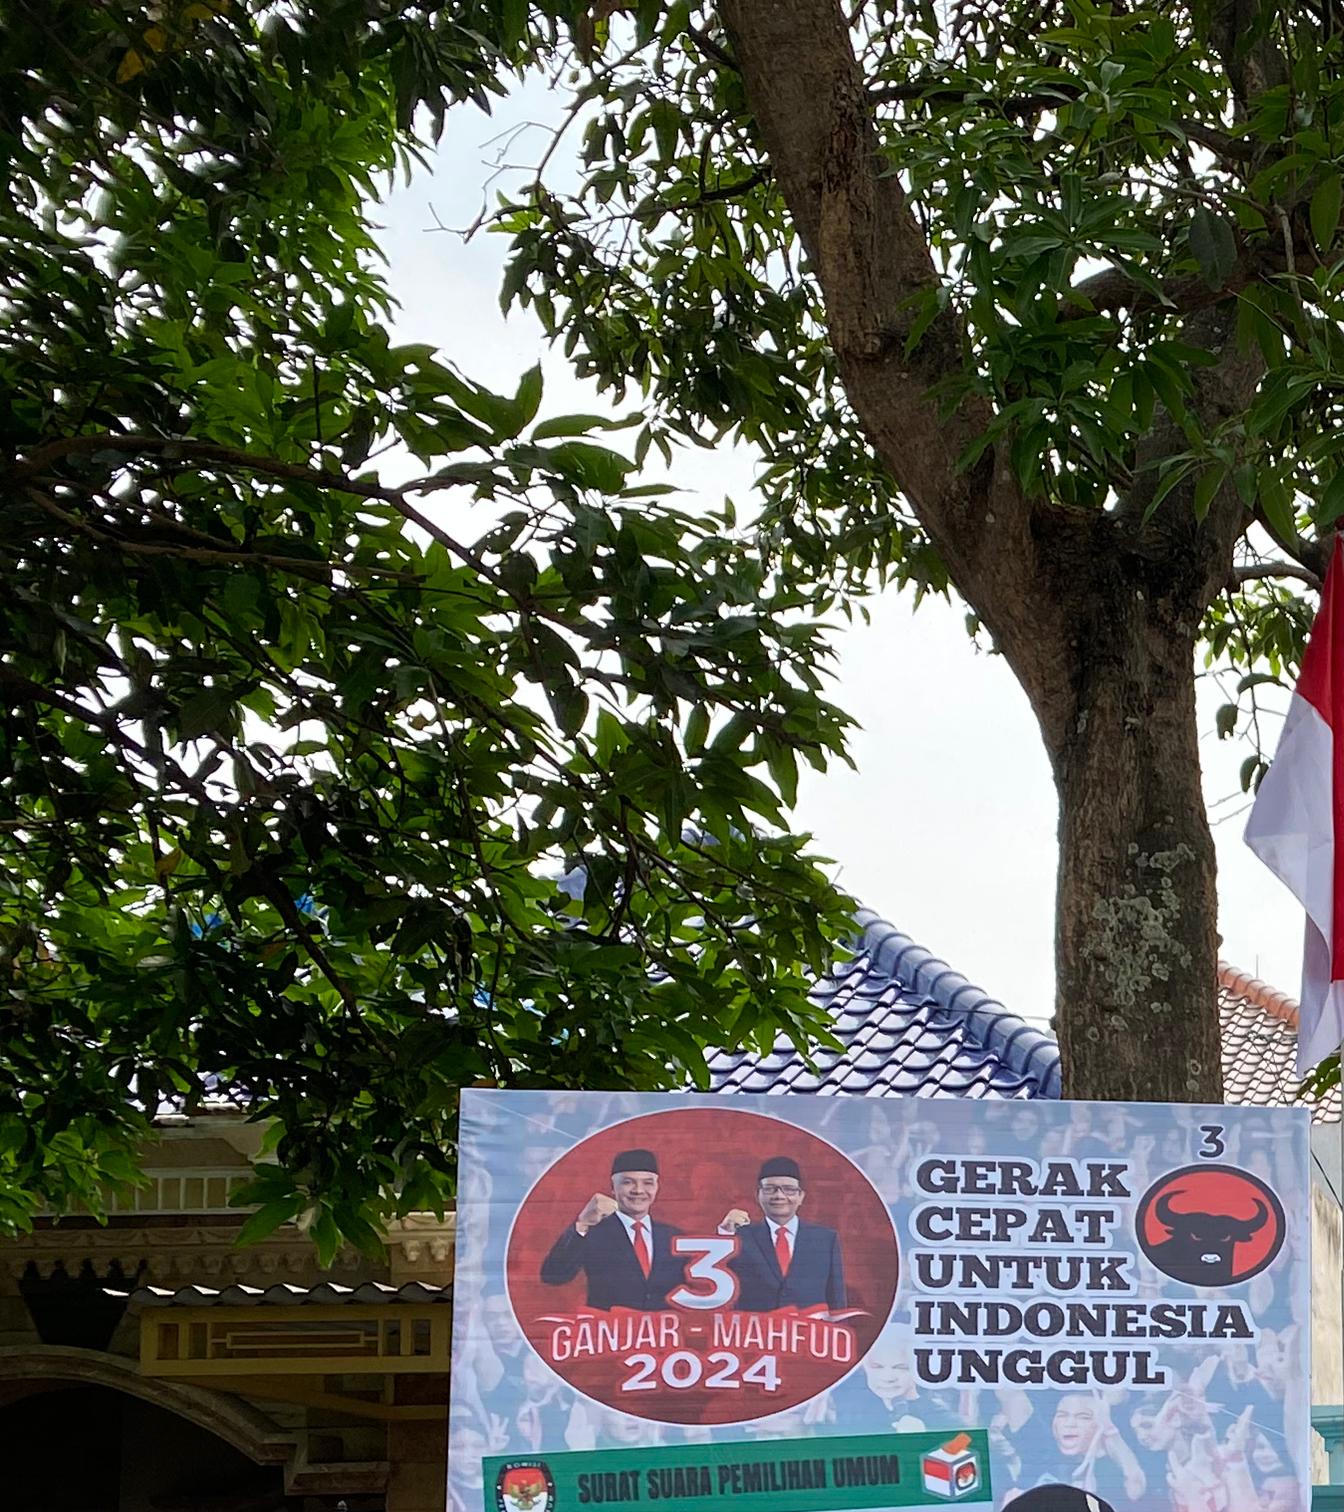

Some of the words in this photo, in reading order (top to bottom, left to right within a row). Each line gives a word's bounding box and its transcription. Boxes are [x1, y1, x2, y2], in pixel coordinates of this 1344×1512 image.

[1199, 1126, 1225, 1158] 3
[916, 1159, 1131, 1198] GERAK
[915, 1206, 1114, 1244] CEPAT
[670, 1238, 736, 1310] 3
[915, 1253, 1131, 1291] UNTUK
[552, 1313, 680, 1361] GANJAR
[713, 1313, 852, 1363] MAHFUD
[914, 1301, 1255, 1339] INDONESIA
[621, 1351, 782, 1392] 2024
[914, 1348, 1166, 1386] UNGGUL
[577, 1469, 640, 1504] SURAT
[648, 1465, 712, 1500] SUARA
[718, 1459, 827, 1496] PEMILIHAN
[834, 1454, 900, 1488] UMUM
